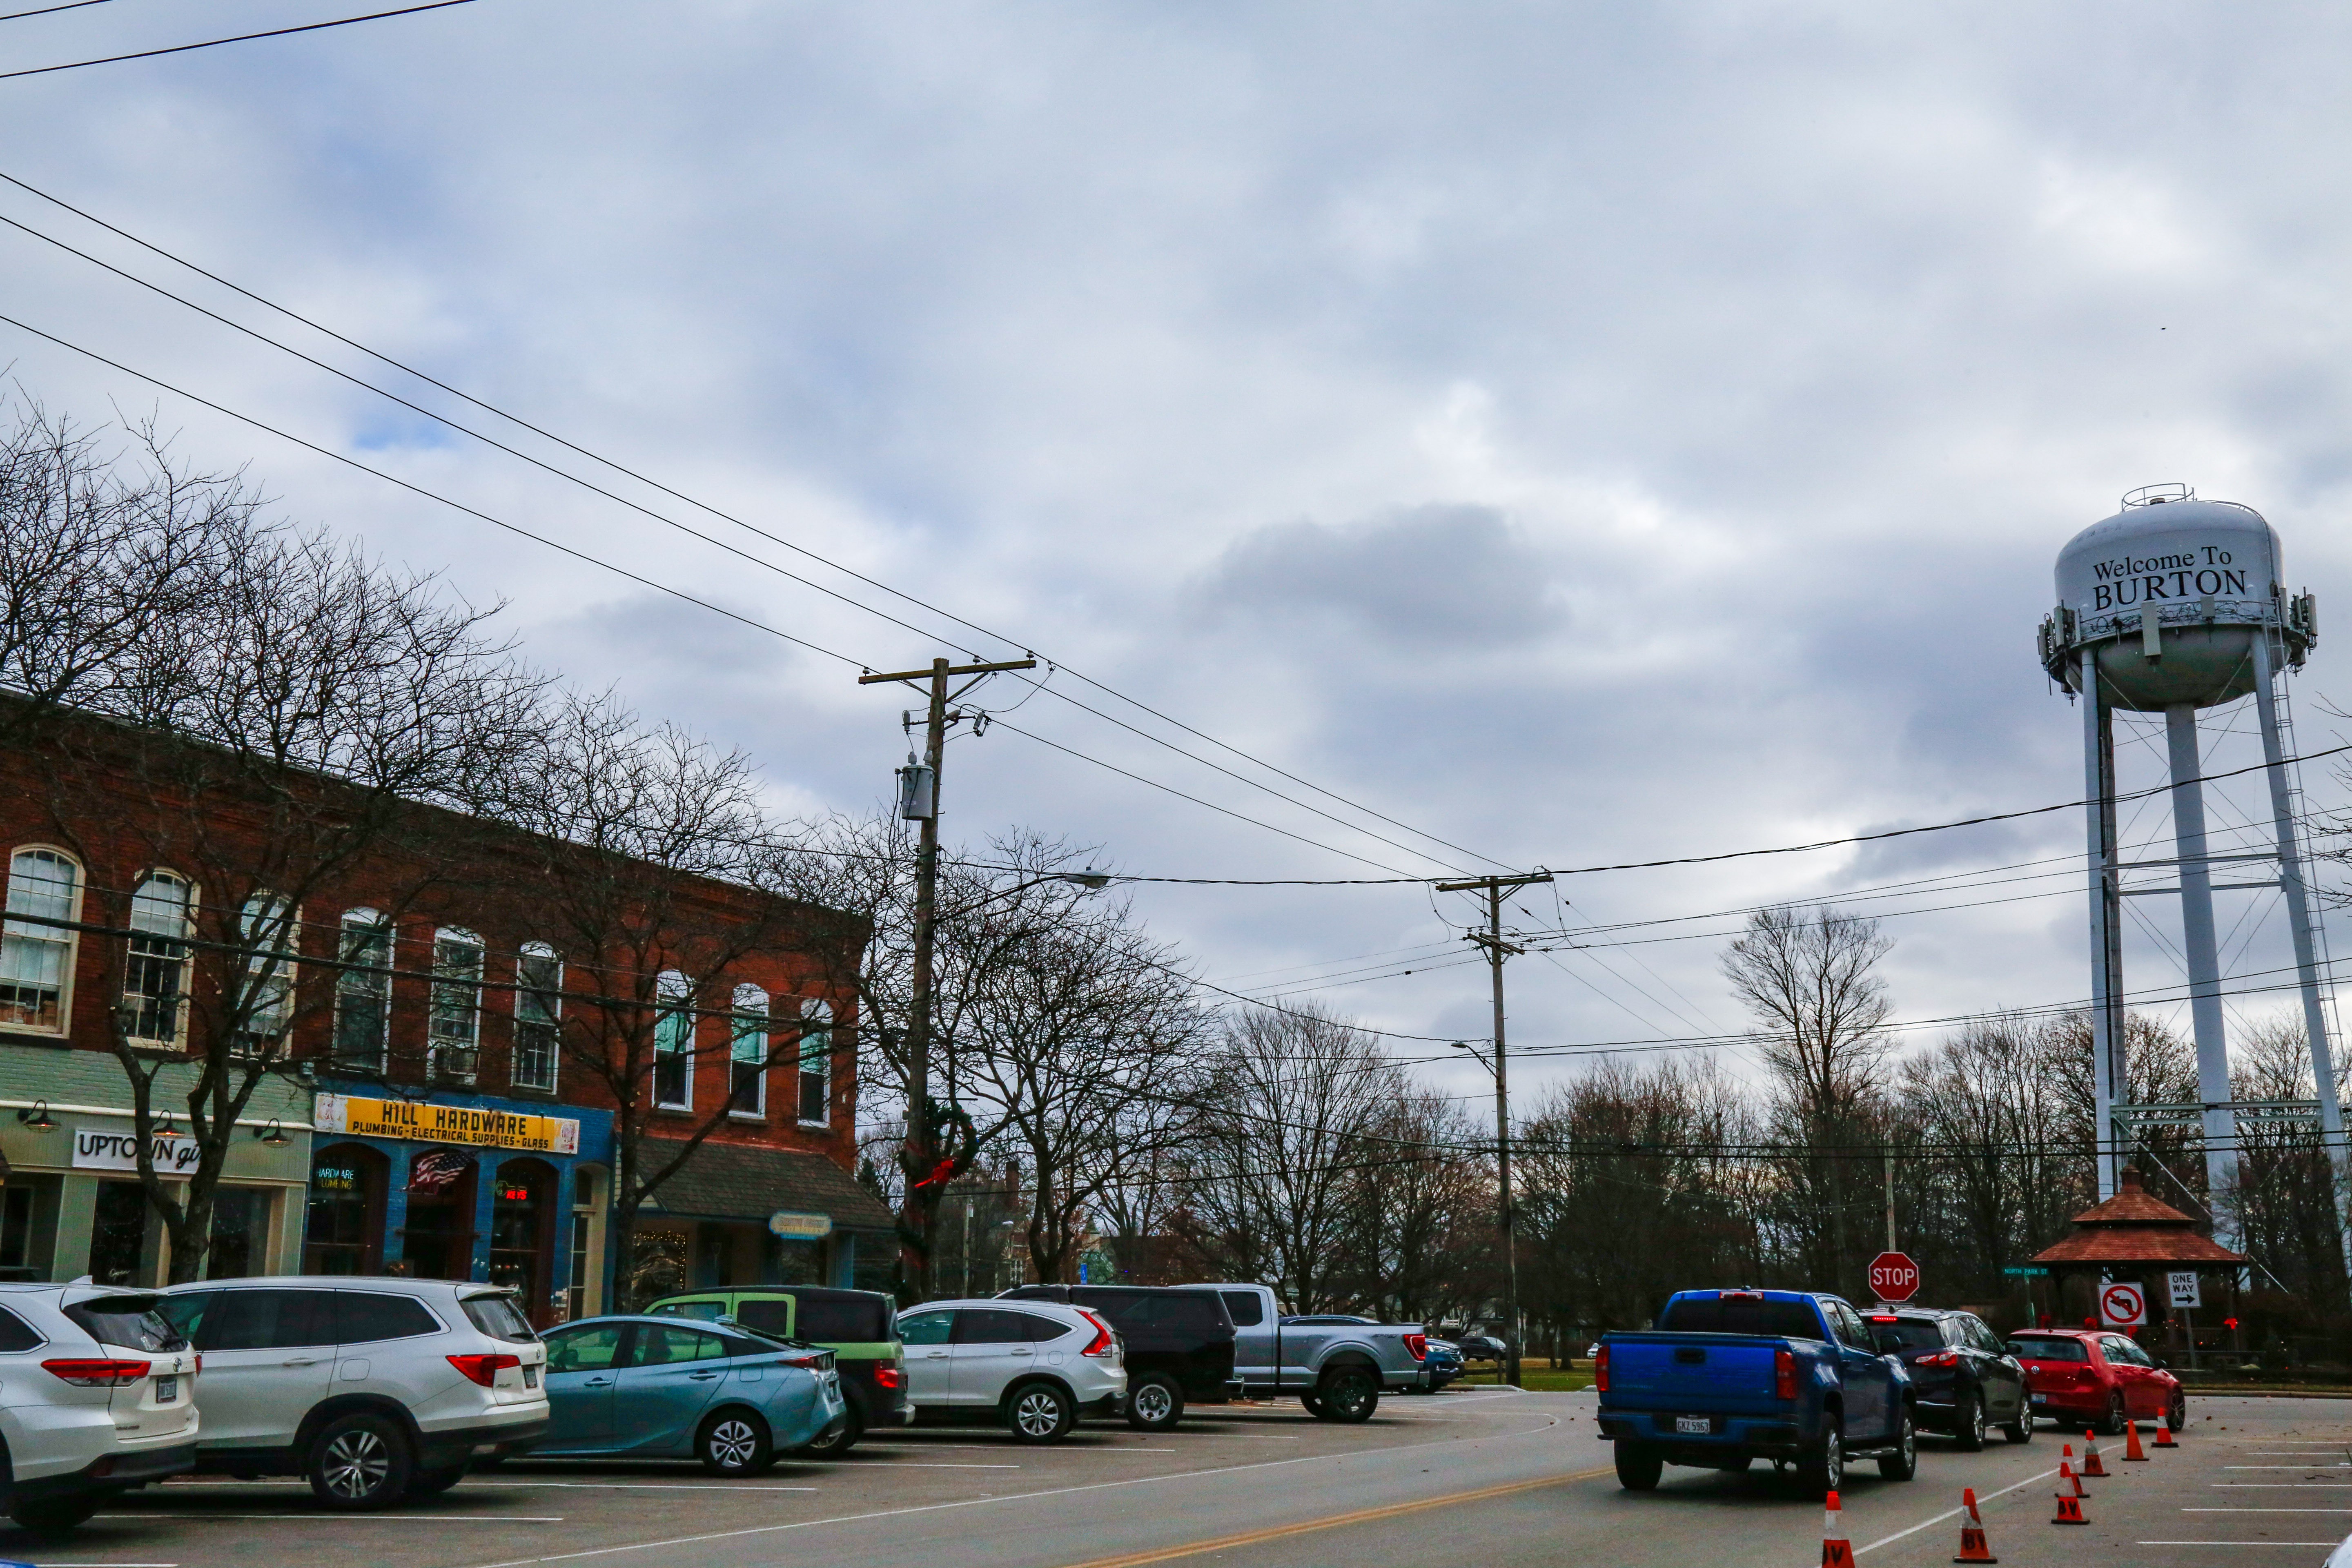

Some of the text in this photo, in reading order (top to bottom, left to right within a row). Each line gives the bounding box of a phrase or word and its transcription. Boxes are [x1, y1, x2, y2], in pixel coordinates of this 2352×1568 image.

[2093, 546, 2232, 581] Welcome To
[2093, 569, 2246, 612] BURTON
[382, 1103, 526, 1136] HILL HARDWARE
[352, 1121, 403, 1136] PLUMBING
[412, 1127, 468, 1142] ELECTRICAL
[472, 1133, 514, 1146] SUPPLIES
[522, 1138, 549, 1149] GLASS
[1873, 1268, 1915, 1285] STOP
[2172, 1275, 2193, 1283] ONE
[2172, 1285, 2194, 1293] WAY
[1677, 1421, 1709, 1431] GKZ 5963
[2058, 1501, 2077, 1516] BV
